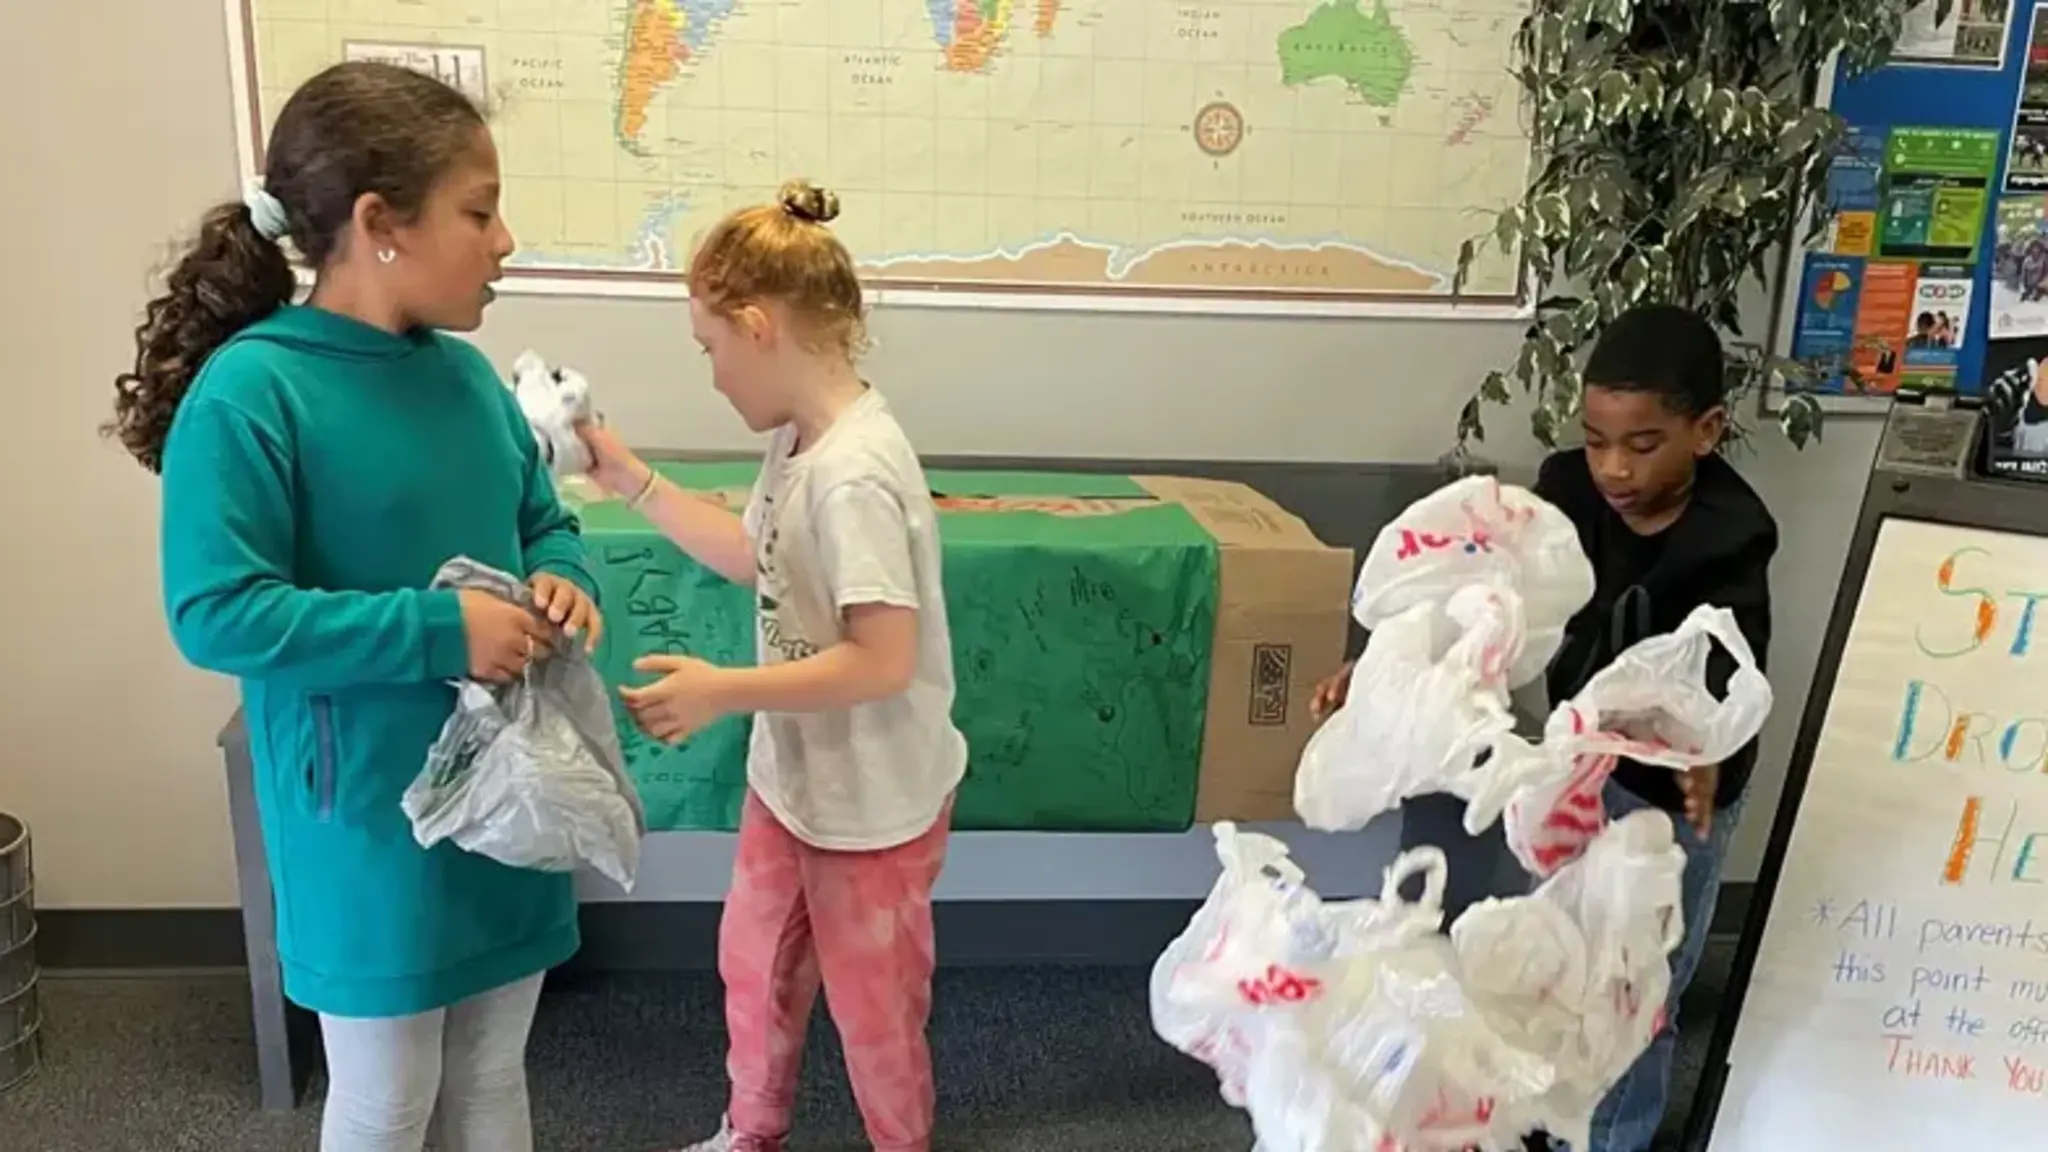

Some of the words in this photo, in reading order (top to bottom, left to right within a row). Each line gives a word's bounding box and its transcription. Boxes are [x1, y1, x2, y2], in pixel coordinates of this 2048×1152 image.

[1177, 28, 1218, 39] OCEAN
[512, 58, 563, 69] PACIFIC
[518, 77, 563, 88] OCEAN
[1895, 680, 2048, 774] DRO
[1833, 949, 1886, 983] this
[1910, 965, 1991, 997] point
[1882, 1000, 1922, 1028] at
[1945, 1005, 1986, 1036] the
[1881, 1033, 1976, 1080] THANK
